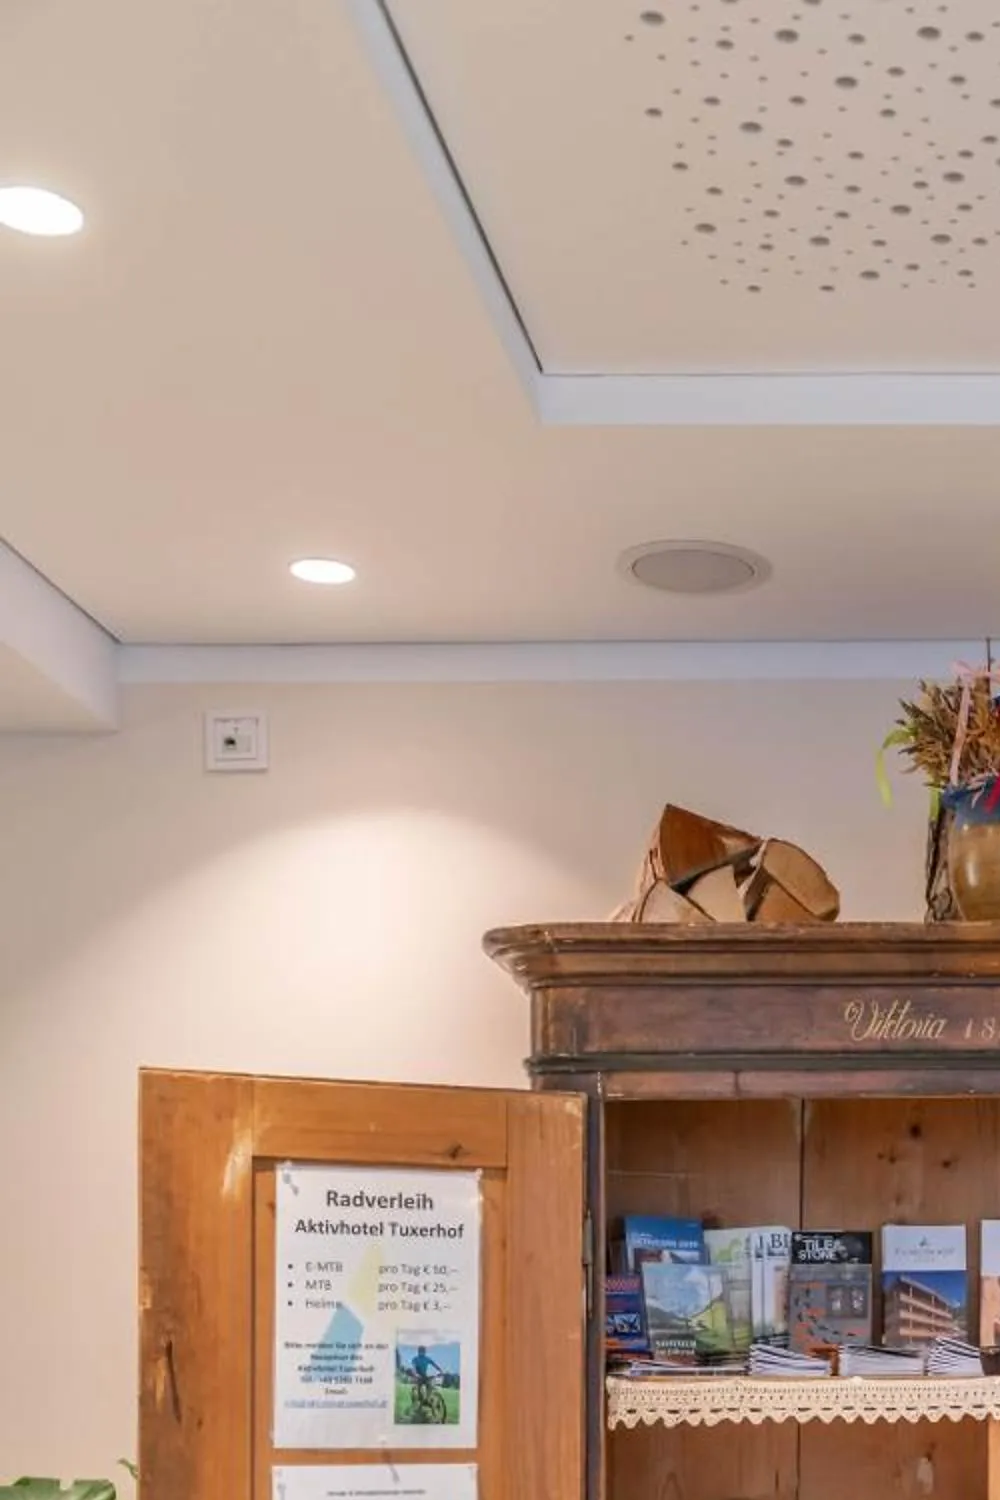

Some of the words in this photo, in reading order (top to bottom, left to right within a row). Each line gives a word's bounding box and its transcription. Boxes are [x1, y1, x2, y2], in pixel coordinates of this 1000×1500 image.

[844, 1000, 947, 1041] Viktoria
[326, 1190, 434, 1211] Radverleih
[295, 1219, 384, 1237] Aktivhotel
[388, 1222, 465, 1239] Tuxerhof
[799, 1250, 837, 1260] STONE
[378, 1266, 398, 1275] pro
[400, 1264, 421, 1276] Tag
[423, 1265, 430, 1274] €
[305, 1279, 332, 1291] MTB
[378, 1284, 398, 1293] pro
[400, 1282, 421, 1294] Tag
[423, 1283, 430, 1292] €
[378, 1302, 398, 1311] pro
[400, 1300, 421, 1312] Tag
[423, 1301, 430, 1311] €
